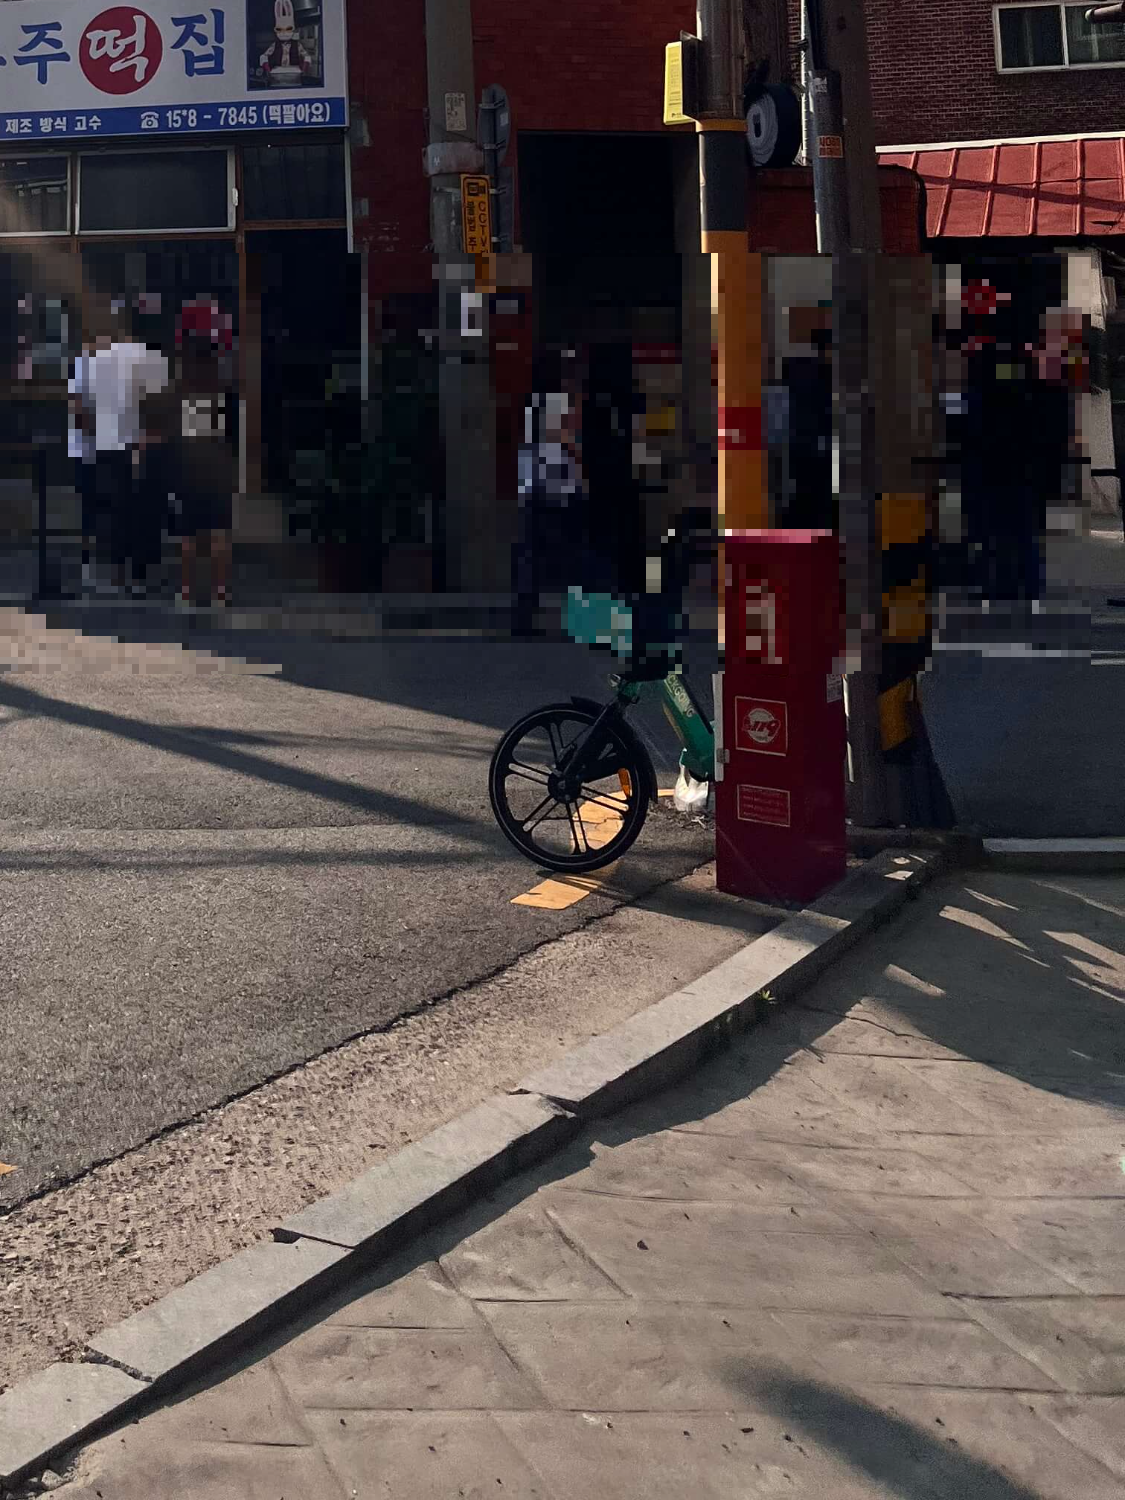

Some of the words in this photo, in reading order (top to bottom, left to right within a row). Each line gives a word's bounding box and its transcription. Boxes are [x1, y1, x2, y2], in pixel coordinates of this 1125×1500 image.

[6, 118, 32, 134] 제조
[40, 116, 67, 132] 방식
[75, 115, 102, 131] 고수
[218, 106, 258, 126] 7845
